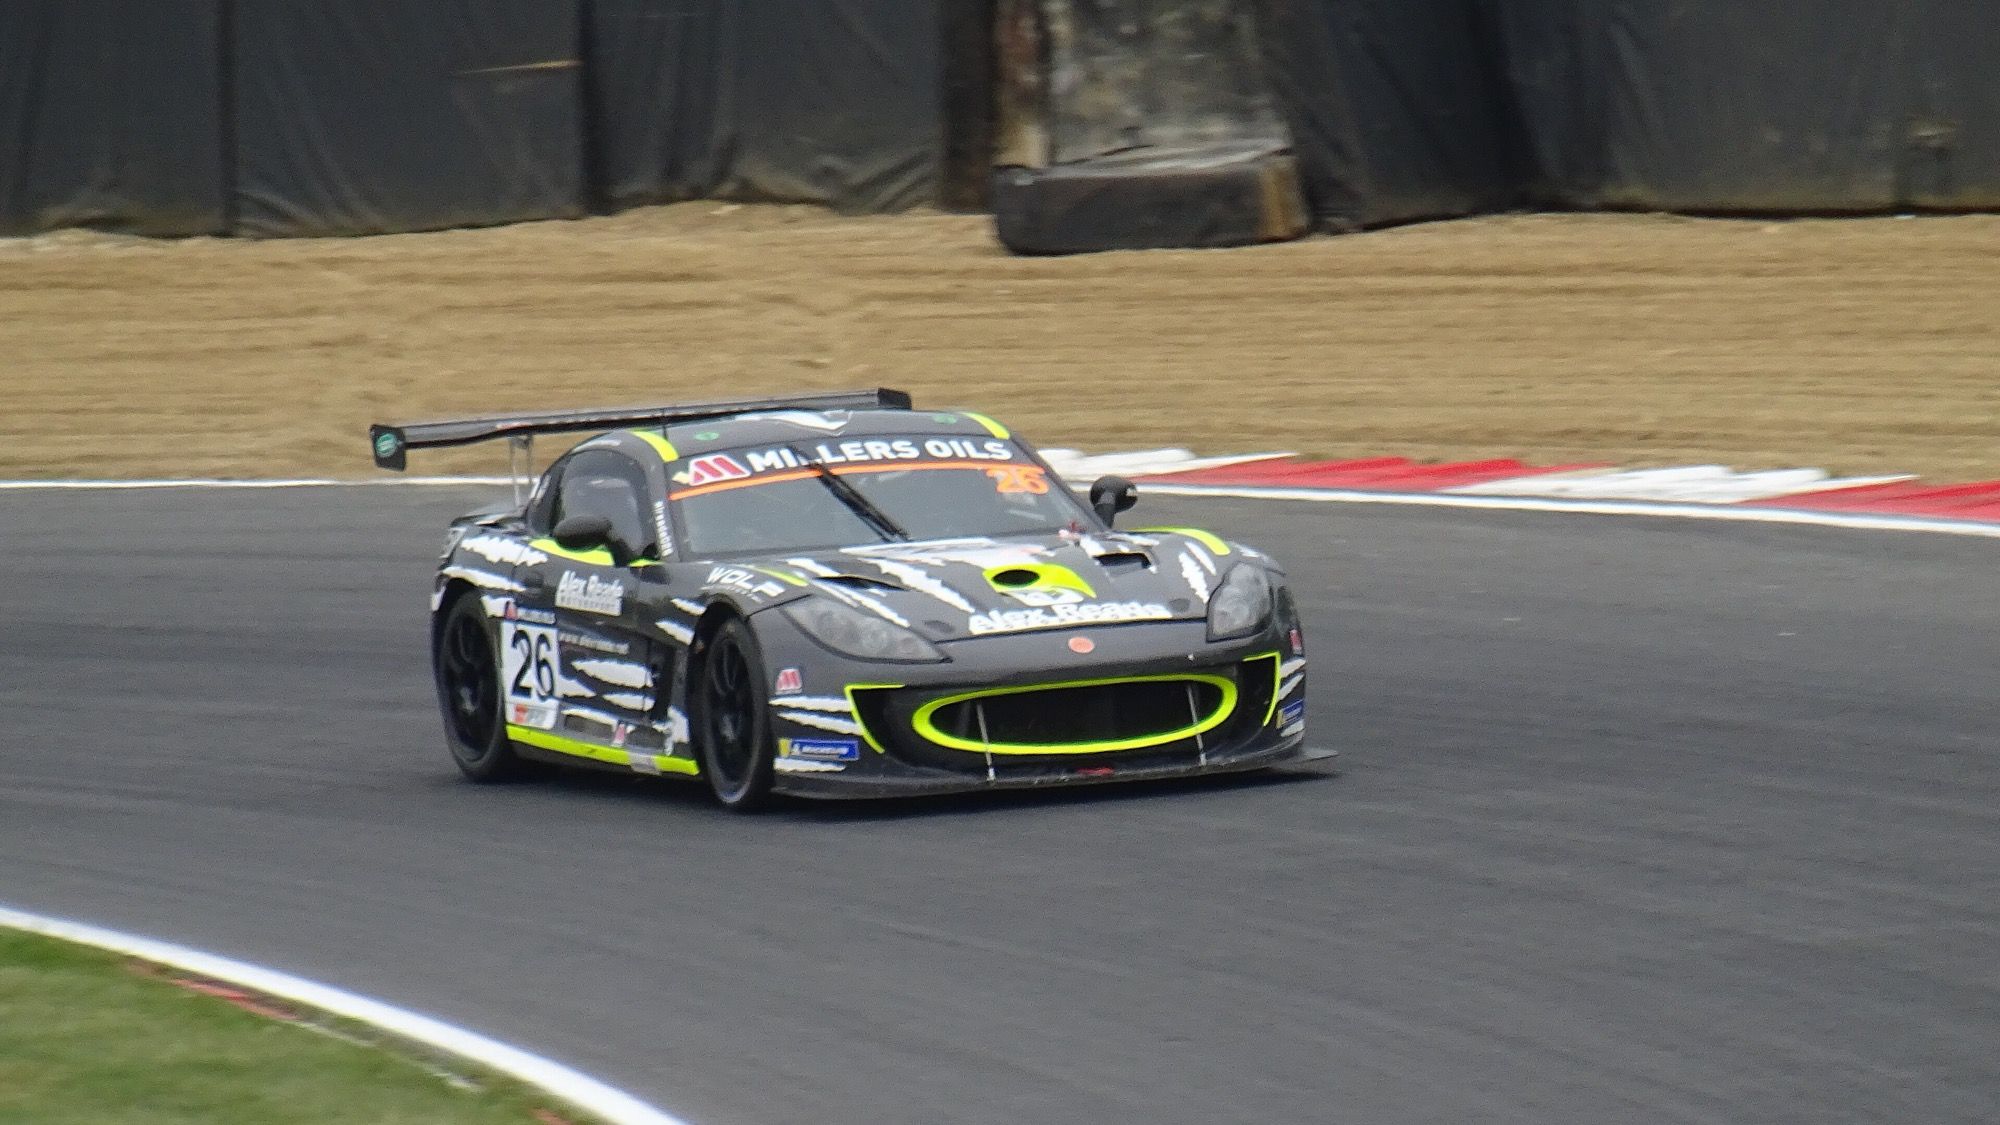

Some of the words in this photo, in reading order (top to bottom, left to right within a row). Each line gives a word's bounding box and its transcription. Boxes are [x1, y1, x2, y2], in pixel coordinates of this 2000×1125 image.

[924, 439, 1013, 461] OILS
[986, 465, 1050, 494] 26
[558, 569, 587, 597] Alex
[511, 629, 554, 702] 26
